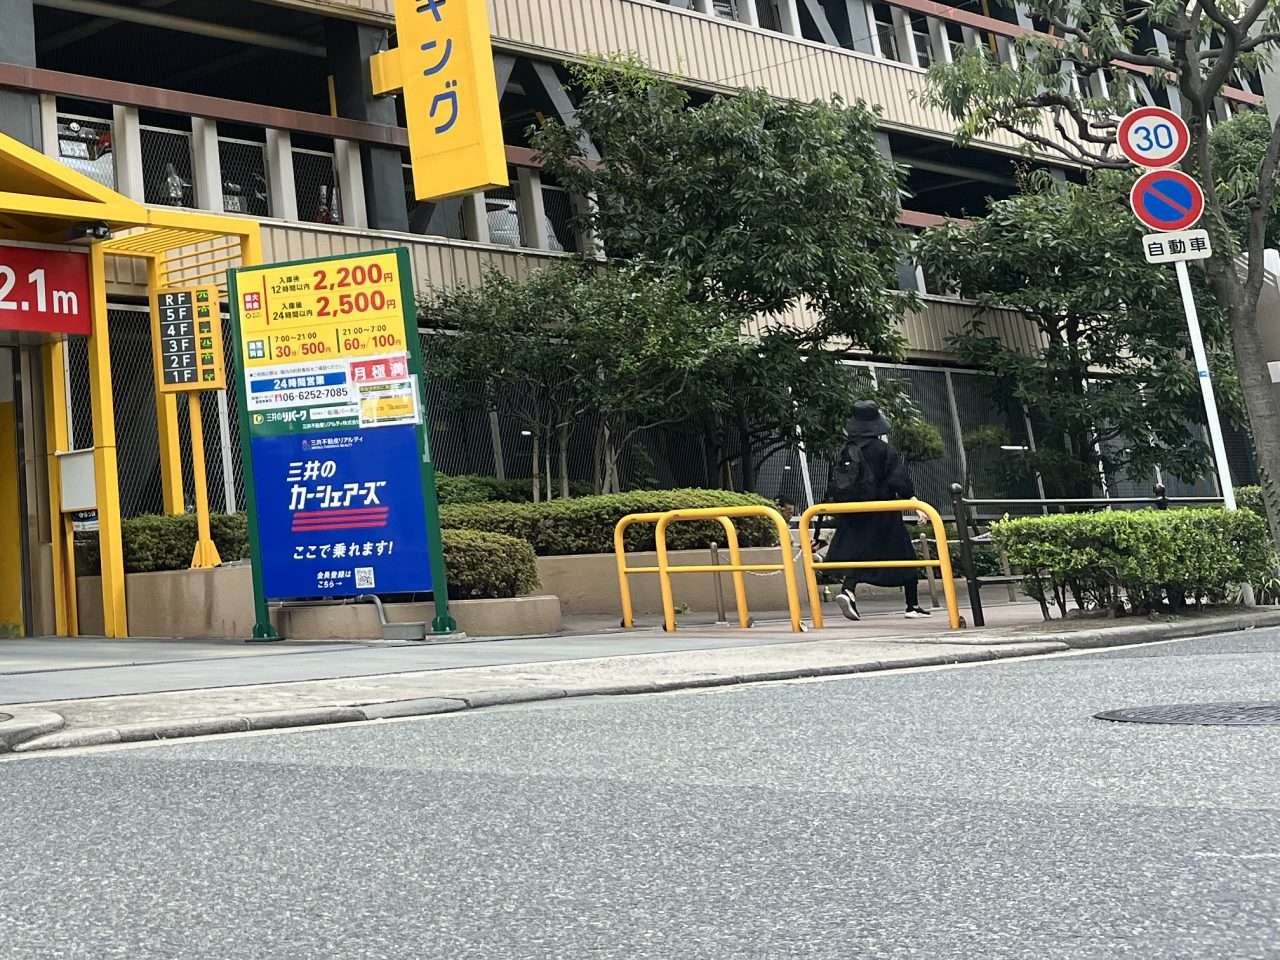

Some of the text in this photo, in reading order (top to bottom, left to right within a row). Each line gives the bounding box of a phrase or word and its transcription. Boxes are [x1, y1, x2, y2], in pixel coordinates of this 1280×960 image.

[1134, 124, 1173, 151] 30
[1148, 237, 1208, 256] 自動車
[313, 263, 393, 290] 2,200円
[316, 290, 396, 317] 2,500円
[273, 375, 325, 390] 24時間営業
[282, 387, 348, 402] 06-6252-7085
[286, 460, 336, 481] 三井の
[288, 481, 387, 509] カーシェアーズ
[293, 540, 394, 559] ここで乗れます!
